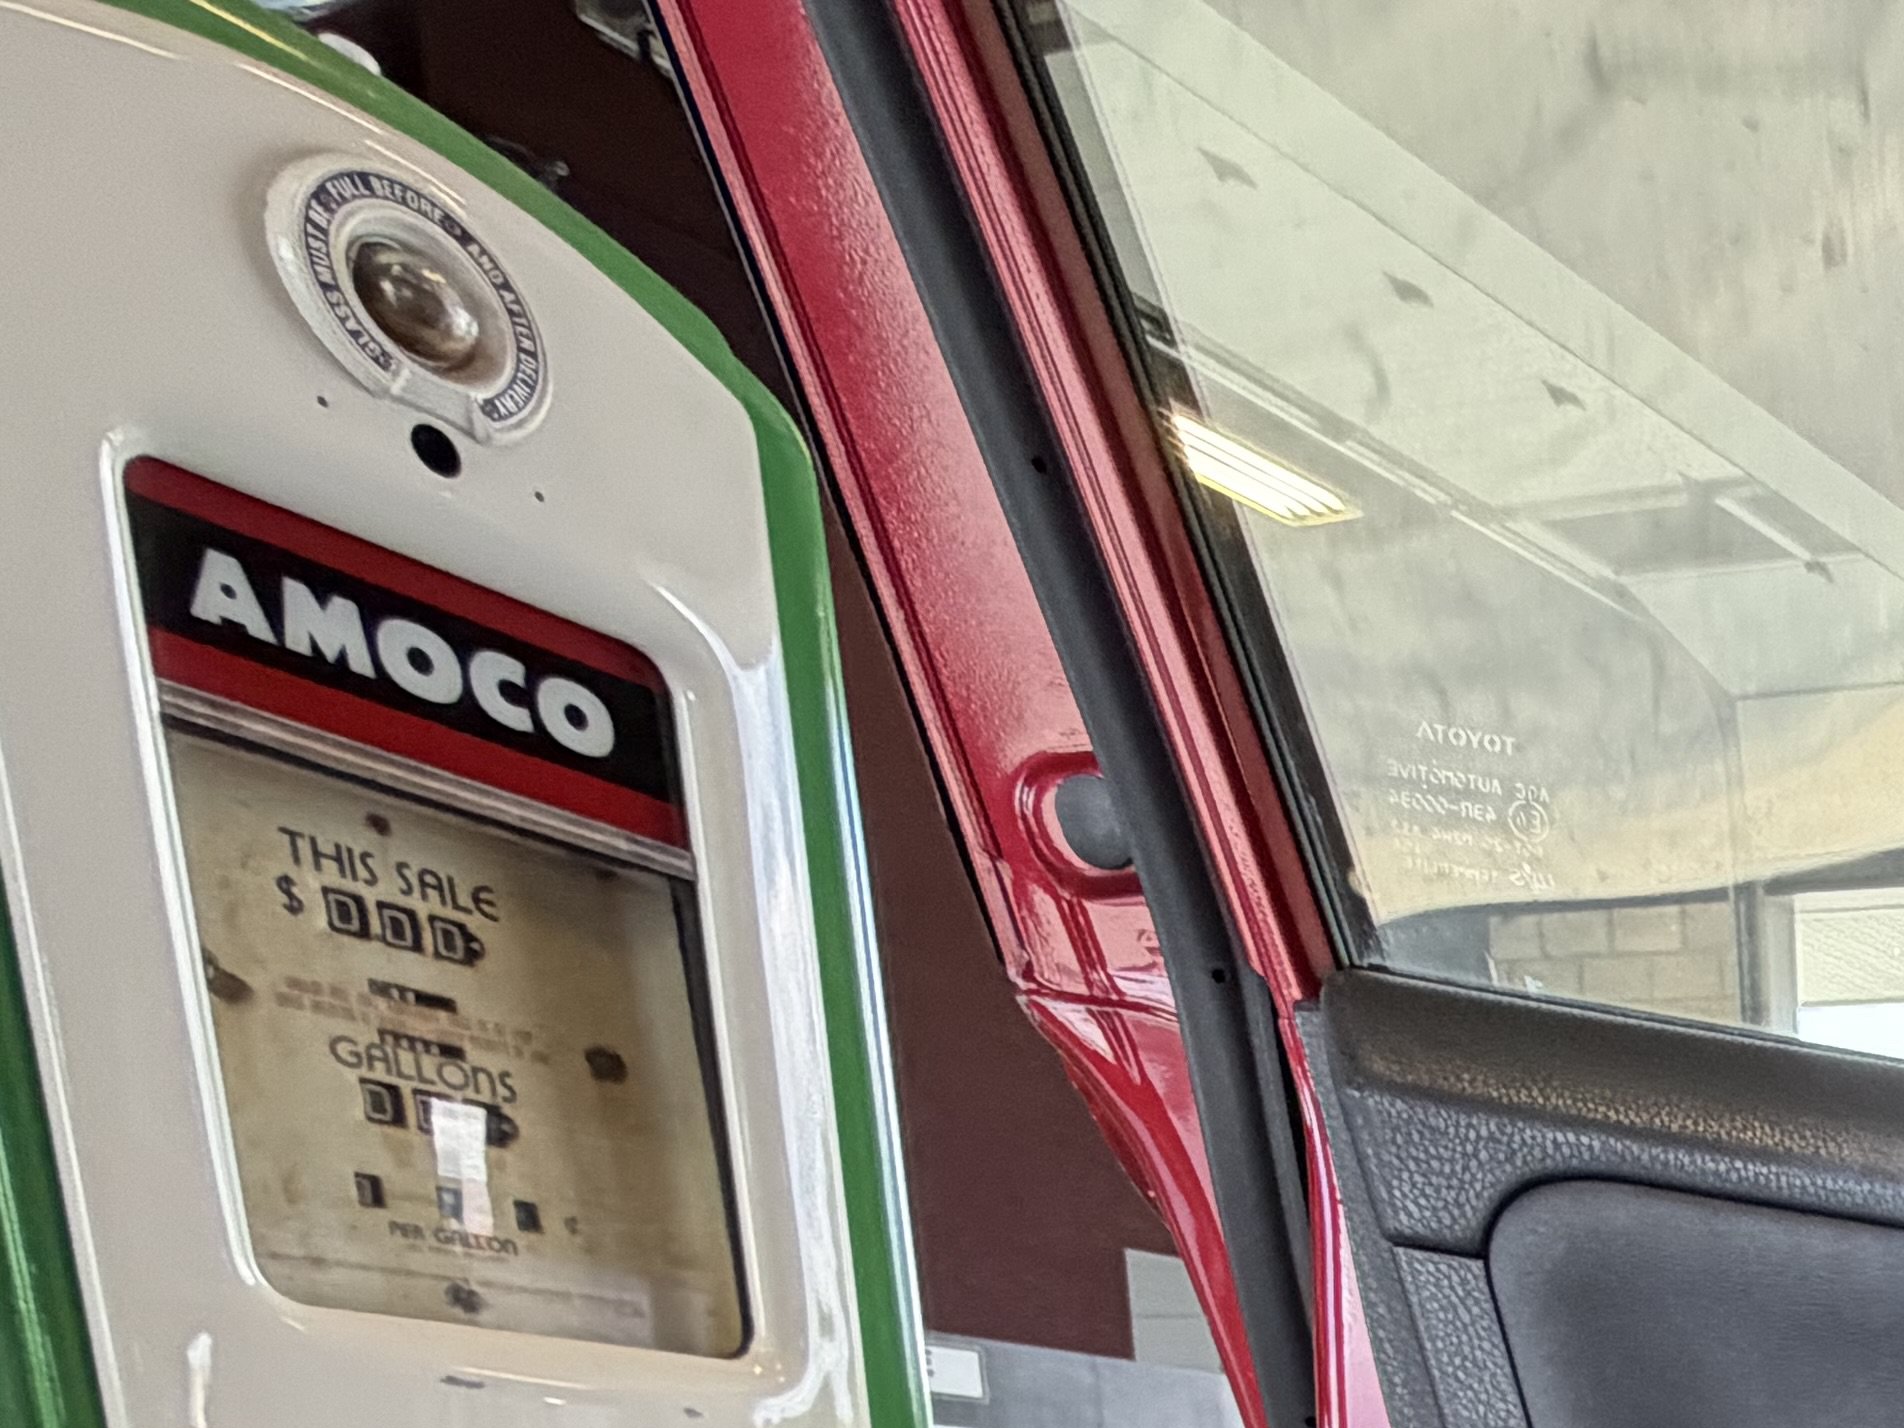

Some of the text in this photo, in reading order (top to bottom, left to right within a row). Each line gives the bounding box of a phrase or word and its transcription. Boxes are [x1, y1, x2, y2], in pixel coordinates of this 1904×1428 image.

[306, 174, 540, 419] GLASS MUST BE FULL BEFORE AND AFTER DELIVERY
[189, 547, 616, 759] AMOCO
[276, 873, 305, 917] $
[277, 826, 499, 922] THIS SALE
[328, 1034, 518, 1105] GALLONS
